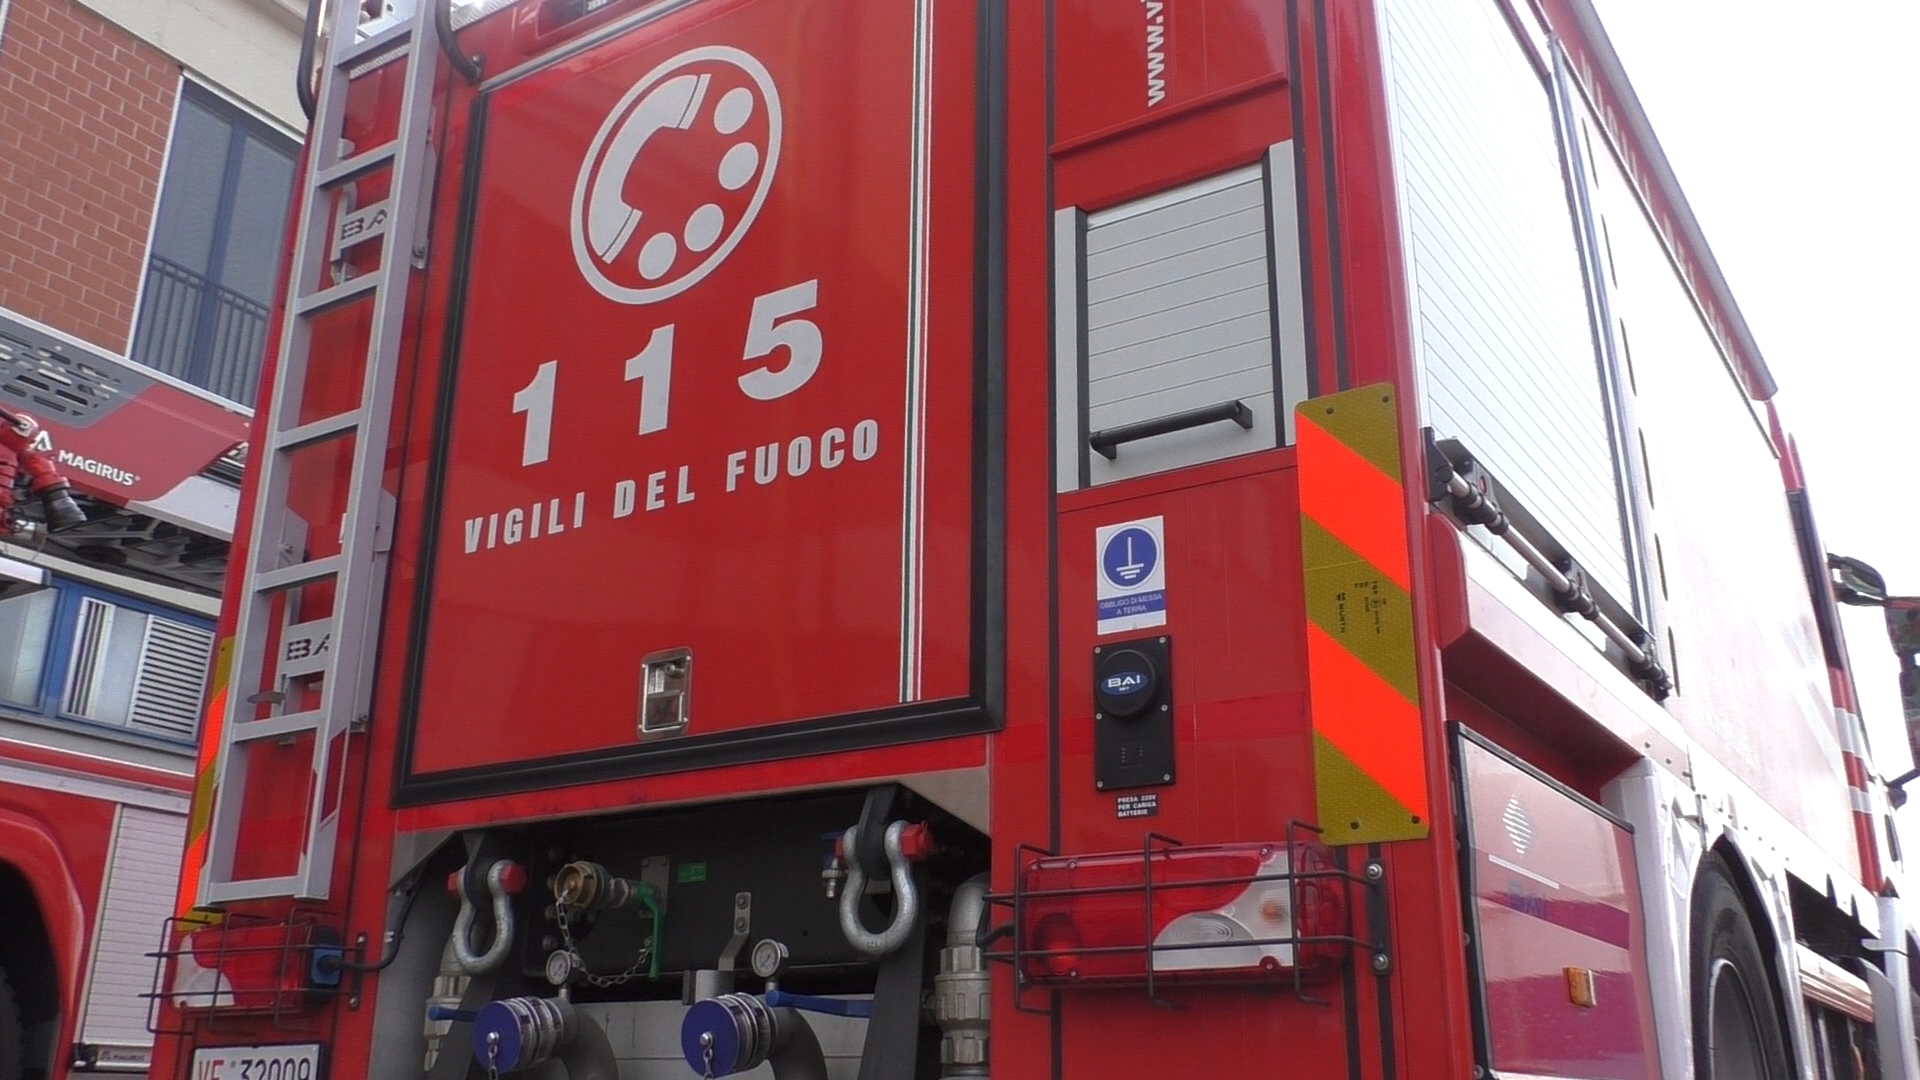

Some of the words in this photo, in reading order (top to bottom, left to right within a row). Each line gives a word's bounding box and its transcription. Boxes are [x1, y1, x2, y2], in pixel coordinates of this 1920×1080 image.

[341, 208, 388, 240] BA
[464, 492, 586, 554] VIGILI
[613, 466, 696, 519] DEL
[726, 419, 879, 492] FUOCO
[1138, 593, 1162, 602] MESSA
[1123, 604, 1147, 614] TERRA
[286, 633, 331, 661] BA
[1108, 674, 1140, 688] BAI
